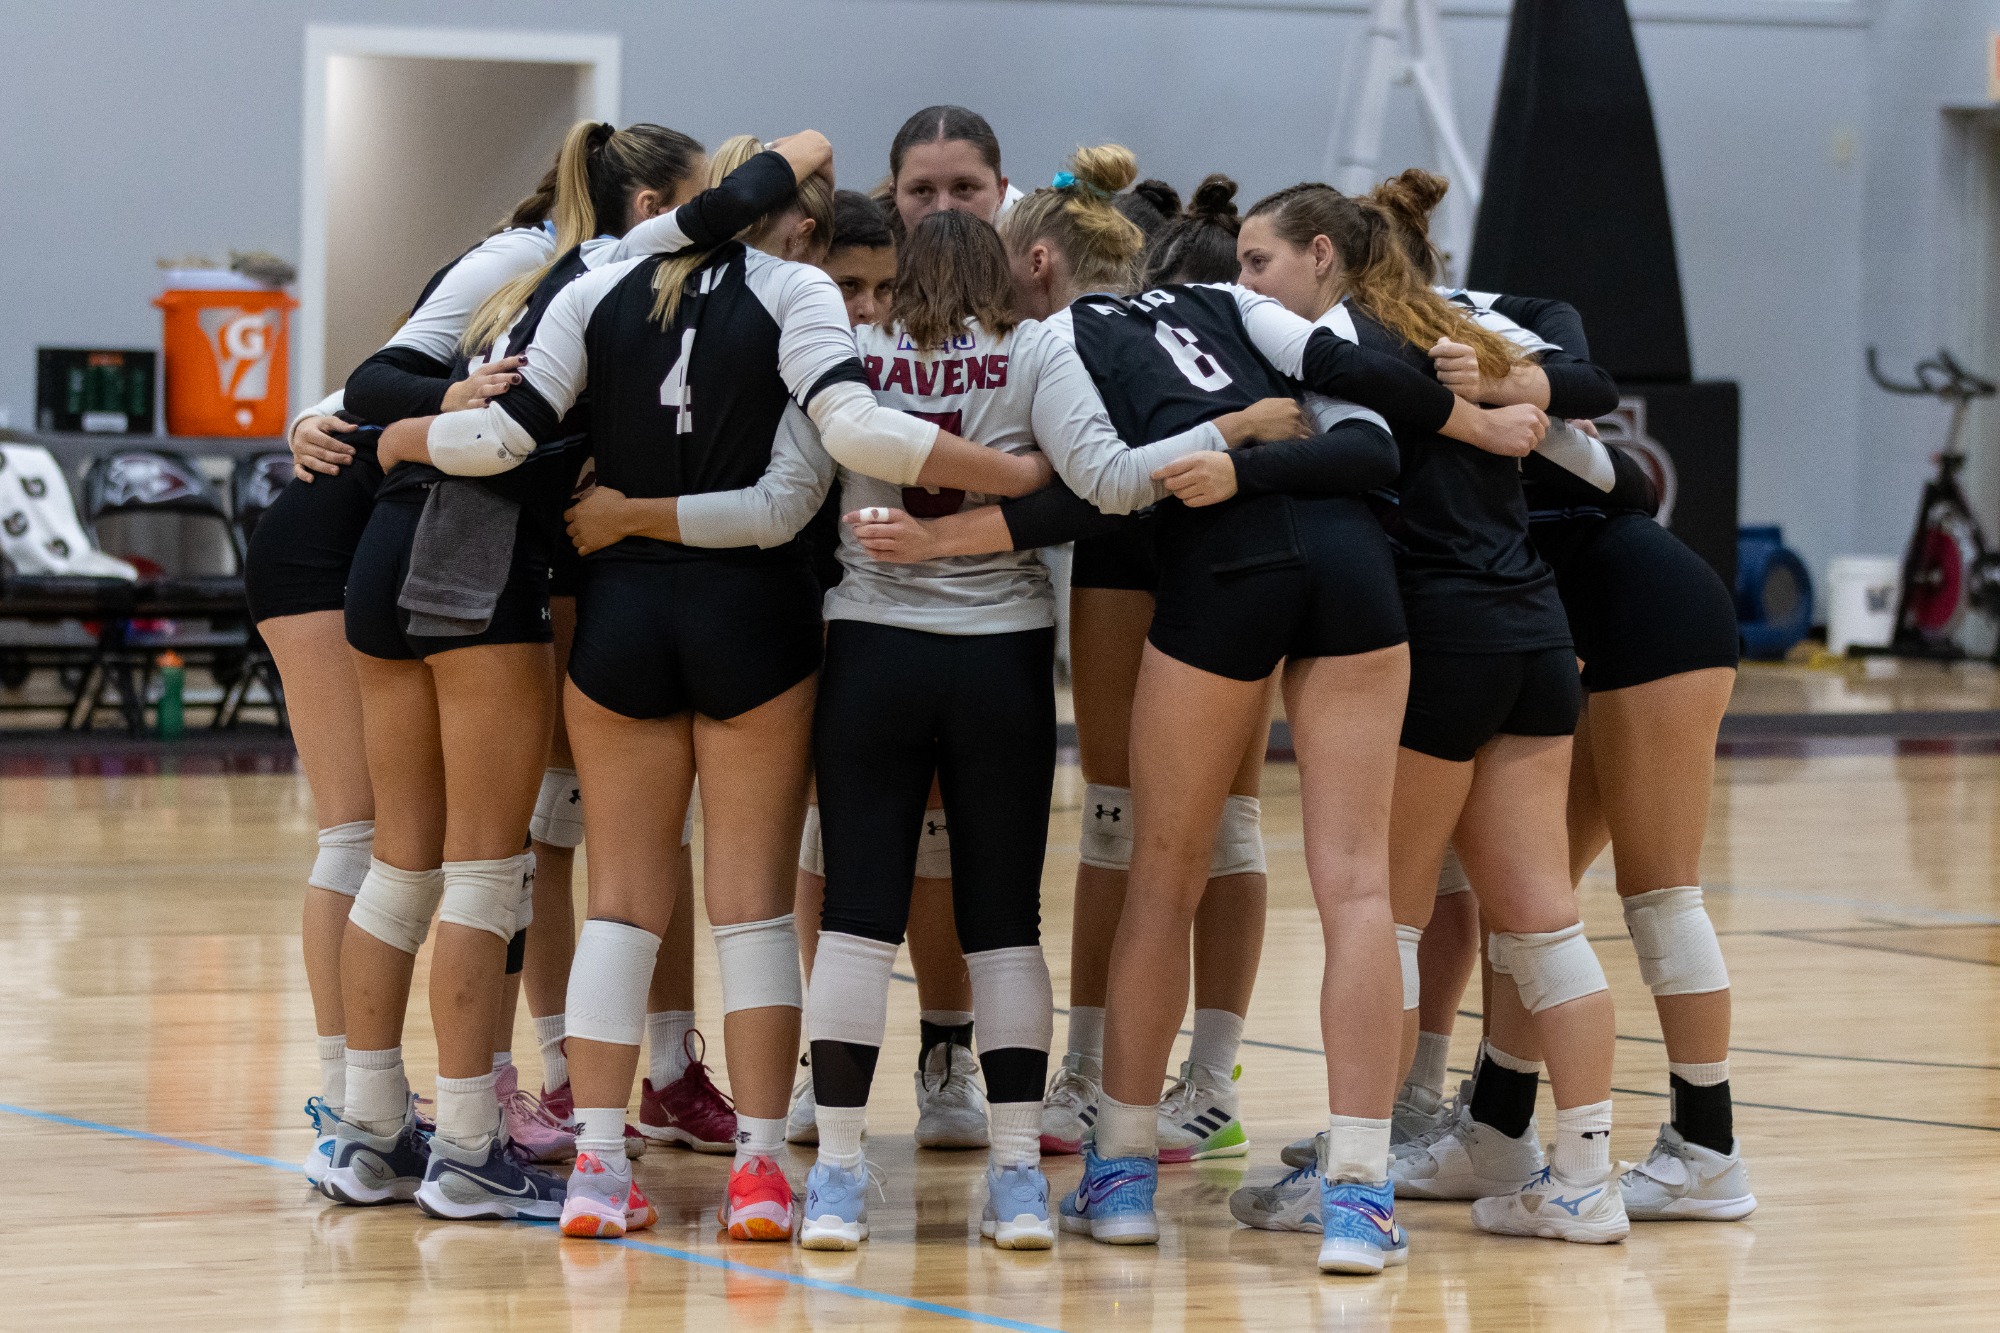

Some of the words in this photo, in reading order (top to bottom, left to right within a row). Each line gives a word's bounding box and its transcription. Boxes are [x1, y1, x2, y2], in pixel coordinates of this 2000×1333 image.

[226, 316, 265, 358] G
[1154, 320, 1233, 392] 6
[659, 328, 693, 435] 4
[863, 352, 1010, 398] RAVENS
